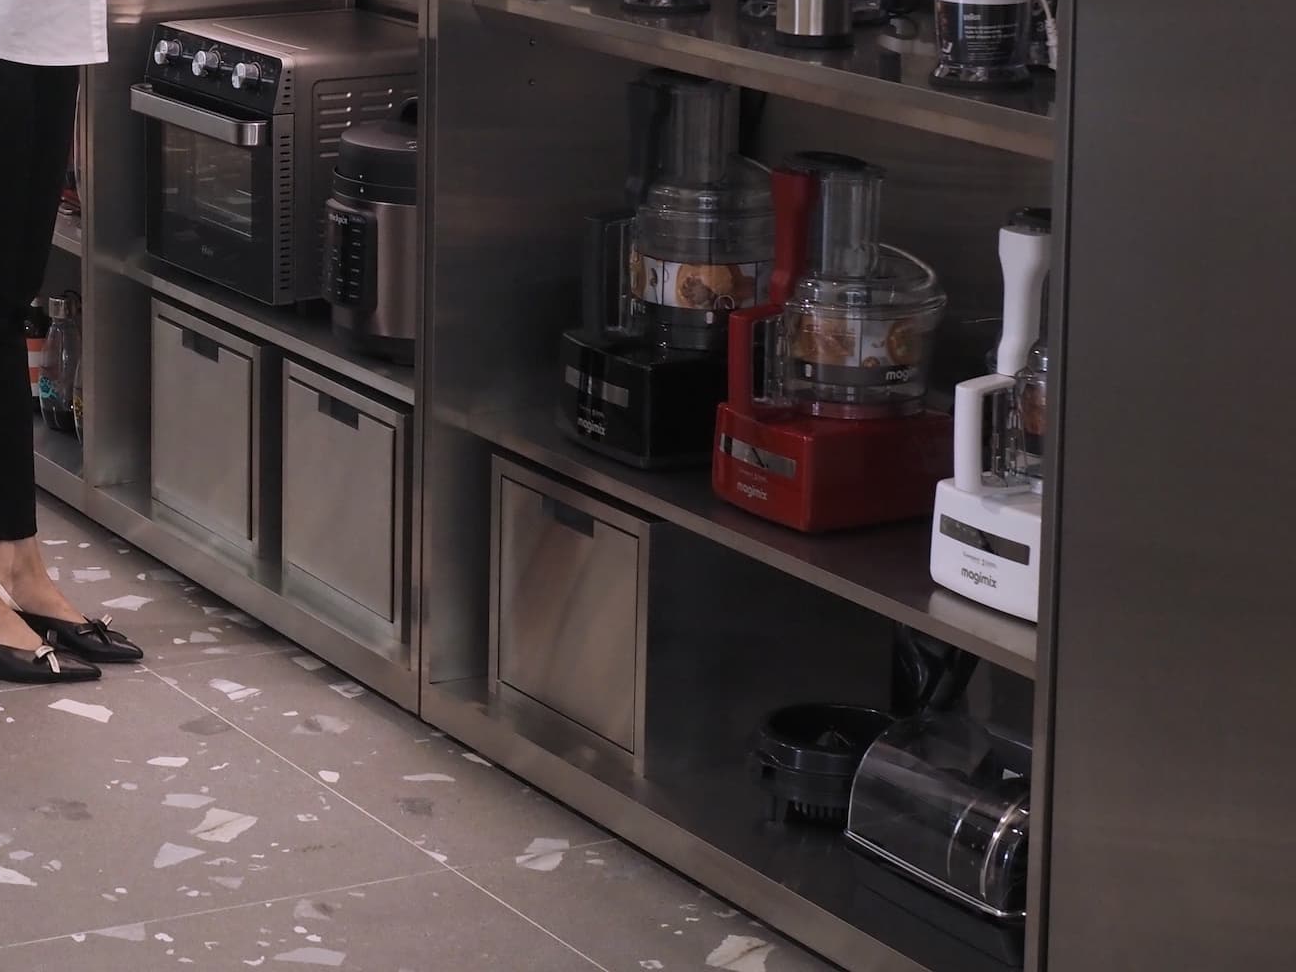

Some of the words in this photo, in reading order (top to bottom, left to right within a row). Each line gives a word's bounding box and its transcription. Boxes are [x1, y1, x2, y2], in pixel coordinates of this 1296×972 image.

[577, 417, 606, 436] magimix
[736, 481, 768, 501] magimix
[960, 567, 997, 589] magimix
